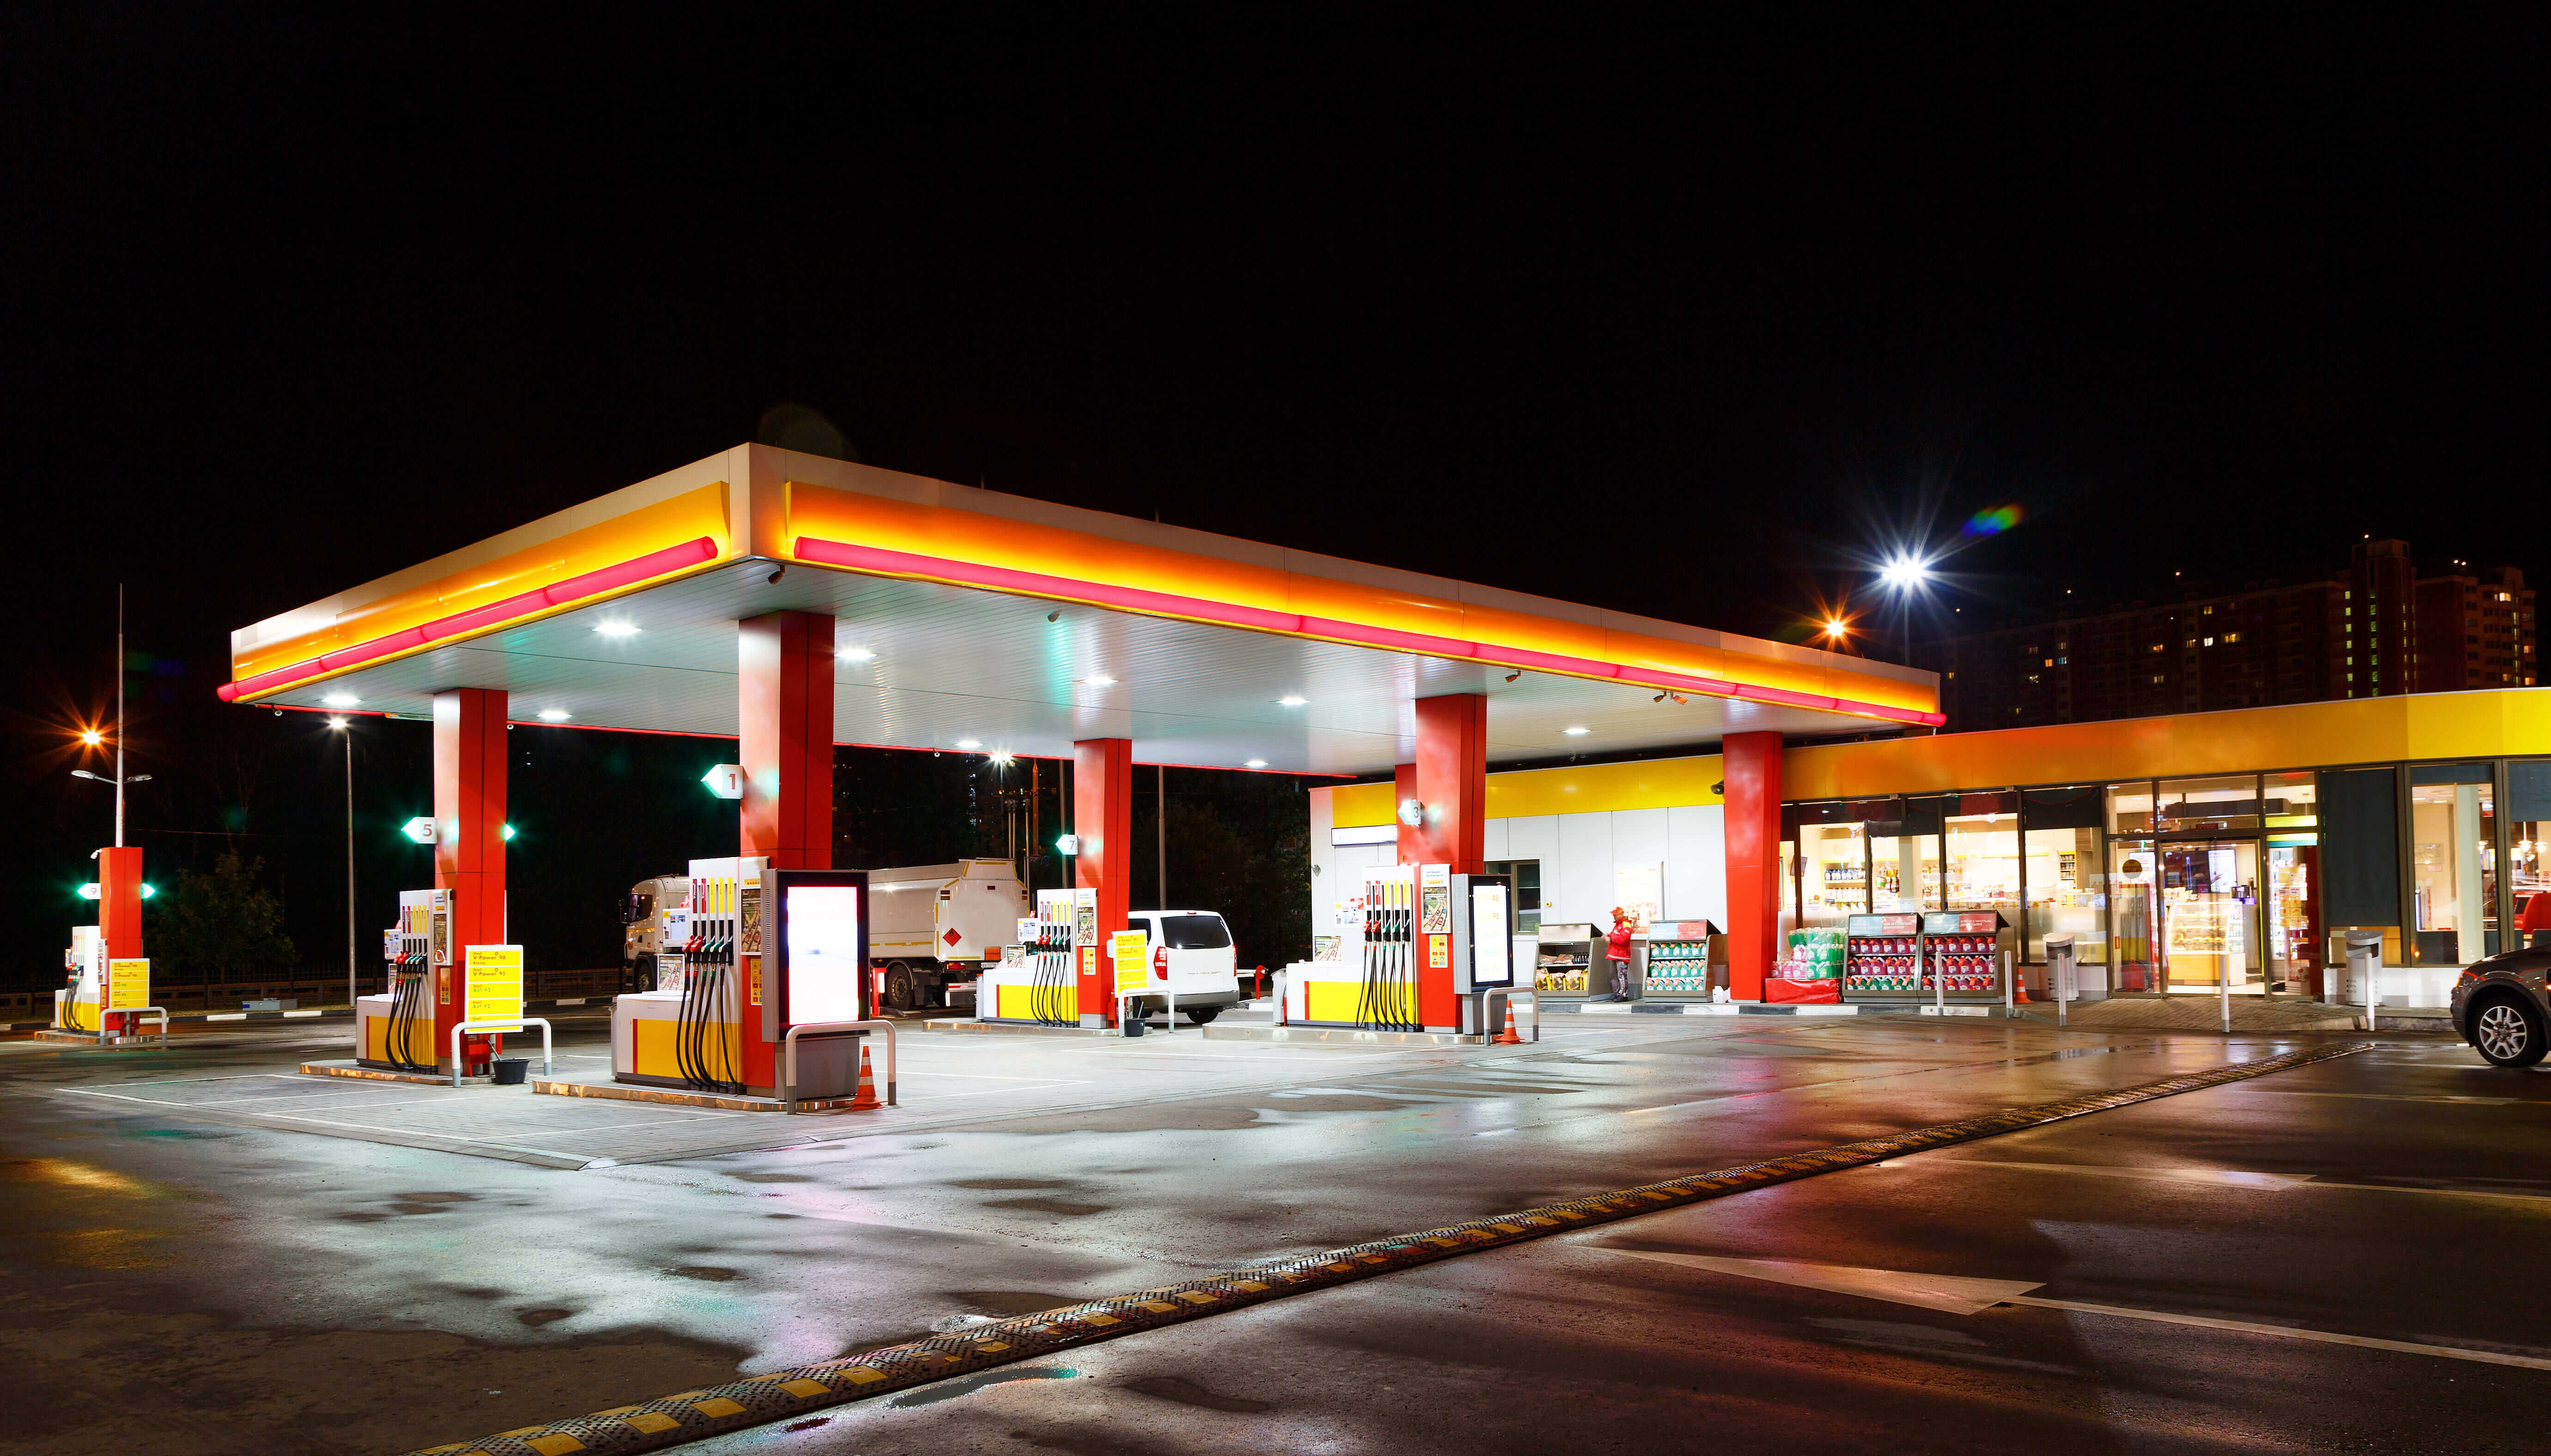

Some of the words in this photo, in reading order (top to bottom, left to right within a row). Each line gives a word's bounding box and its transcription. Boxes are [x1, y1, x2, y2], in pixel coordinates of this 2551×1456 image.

[728, 773, 736, 790] 1
[1414, 807, 1419, 818] 3
[423, 824, 433, 836] 5
[1069, 840, 1075, 849] 7
